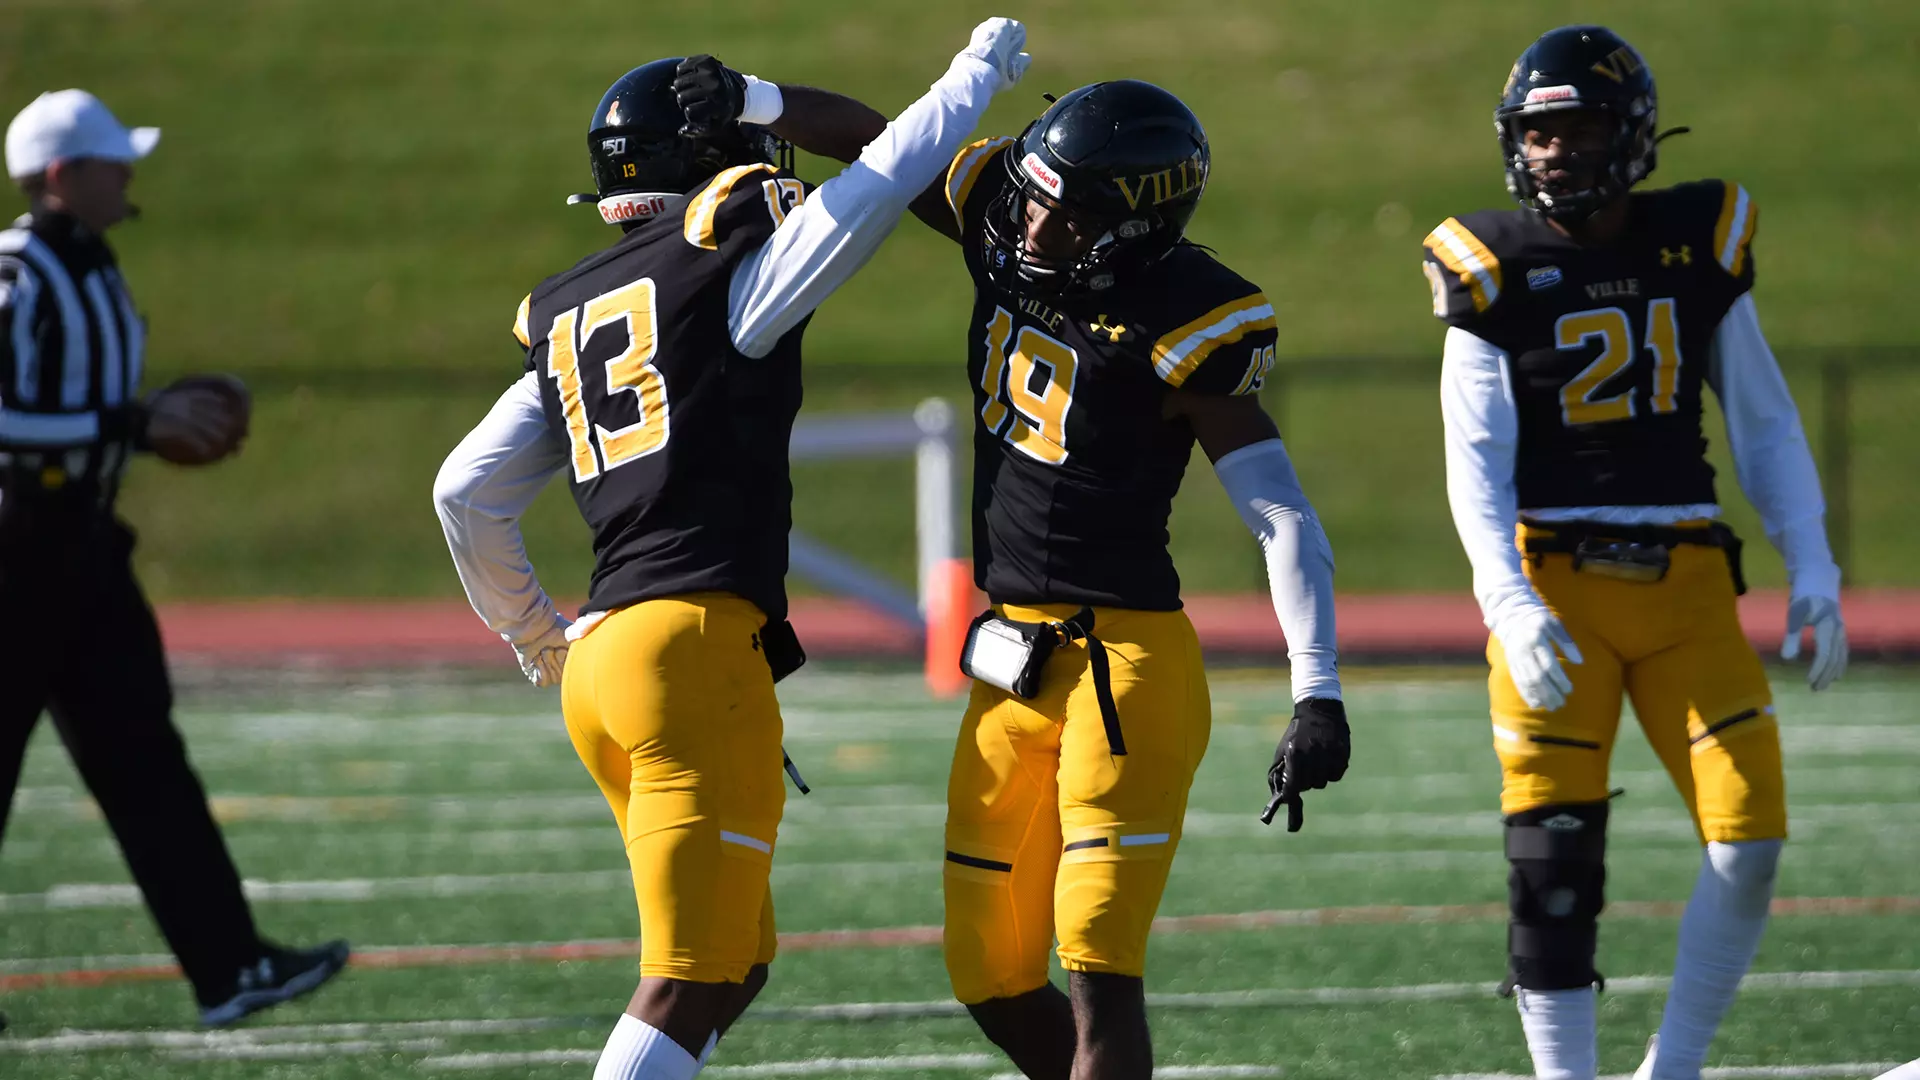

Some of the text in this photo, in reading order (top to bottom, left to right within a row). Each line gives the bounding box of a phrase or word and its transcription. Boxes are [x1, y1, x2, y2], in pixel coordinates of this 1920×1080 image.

[602, 137, 626, 157] 150
[623, 163, 636, 178] 13
[1027, 156, 1060, 190] Riddell
[600, 198, 666, 222] Riddell
[1584, 278, 1639, 300] VILLE
[1018, 291, 1064, 333] VILLE
[1555, 297, 1682, 424] 21
[547, 277, 670, 484] 13
[980, 304, 1079, 466] 19
